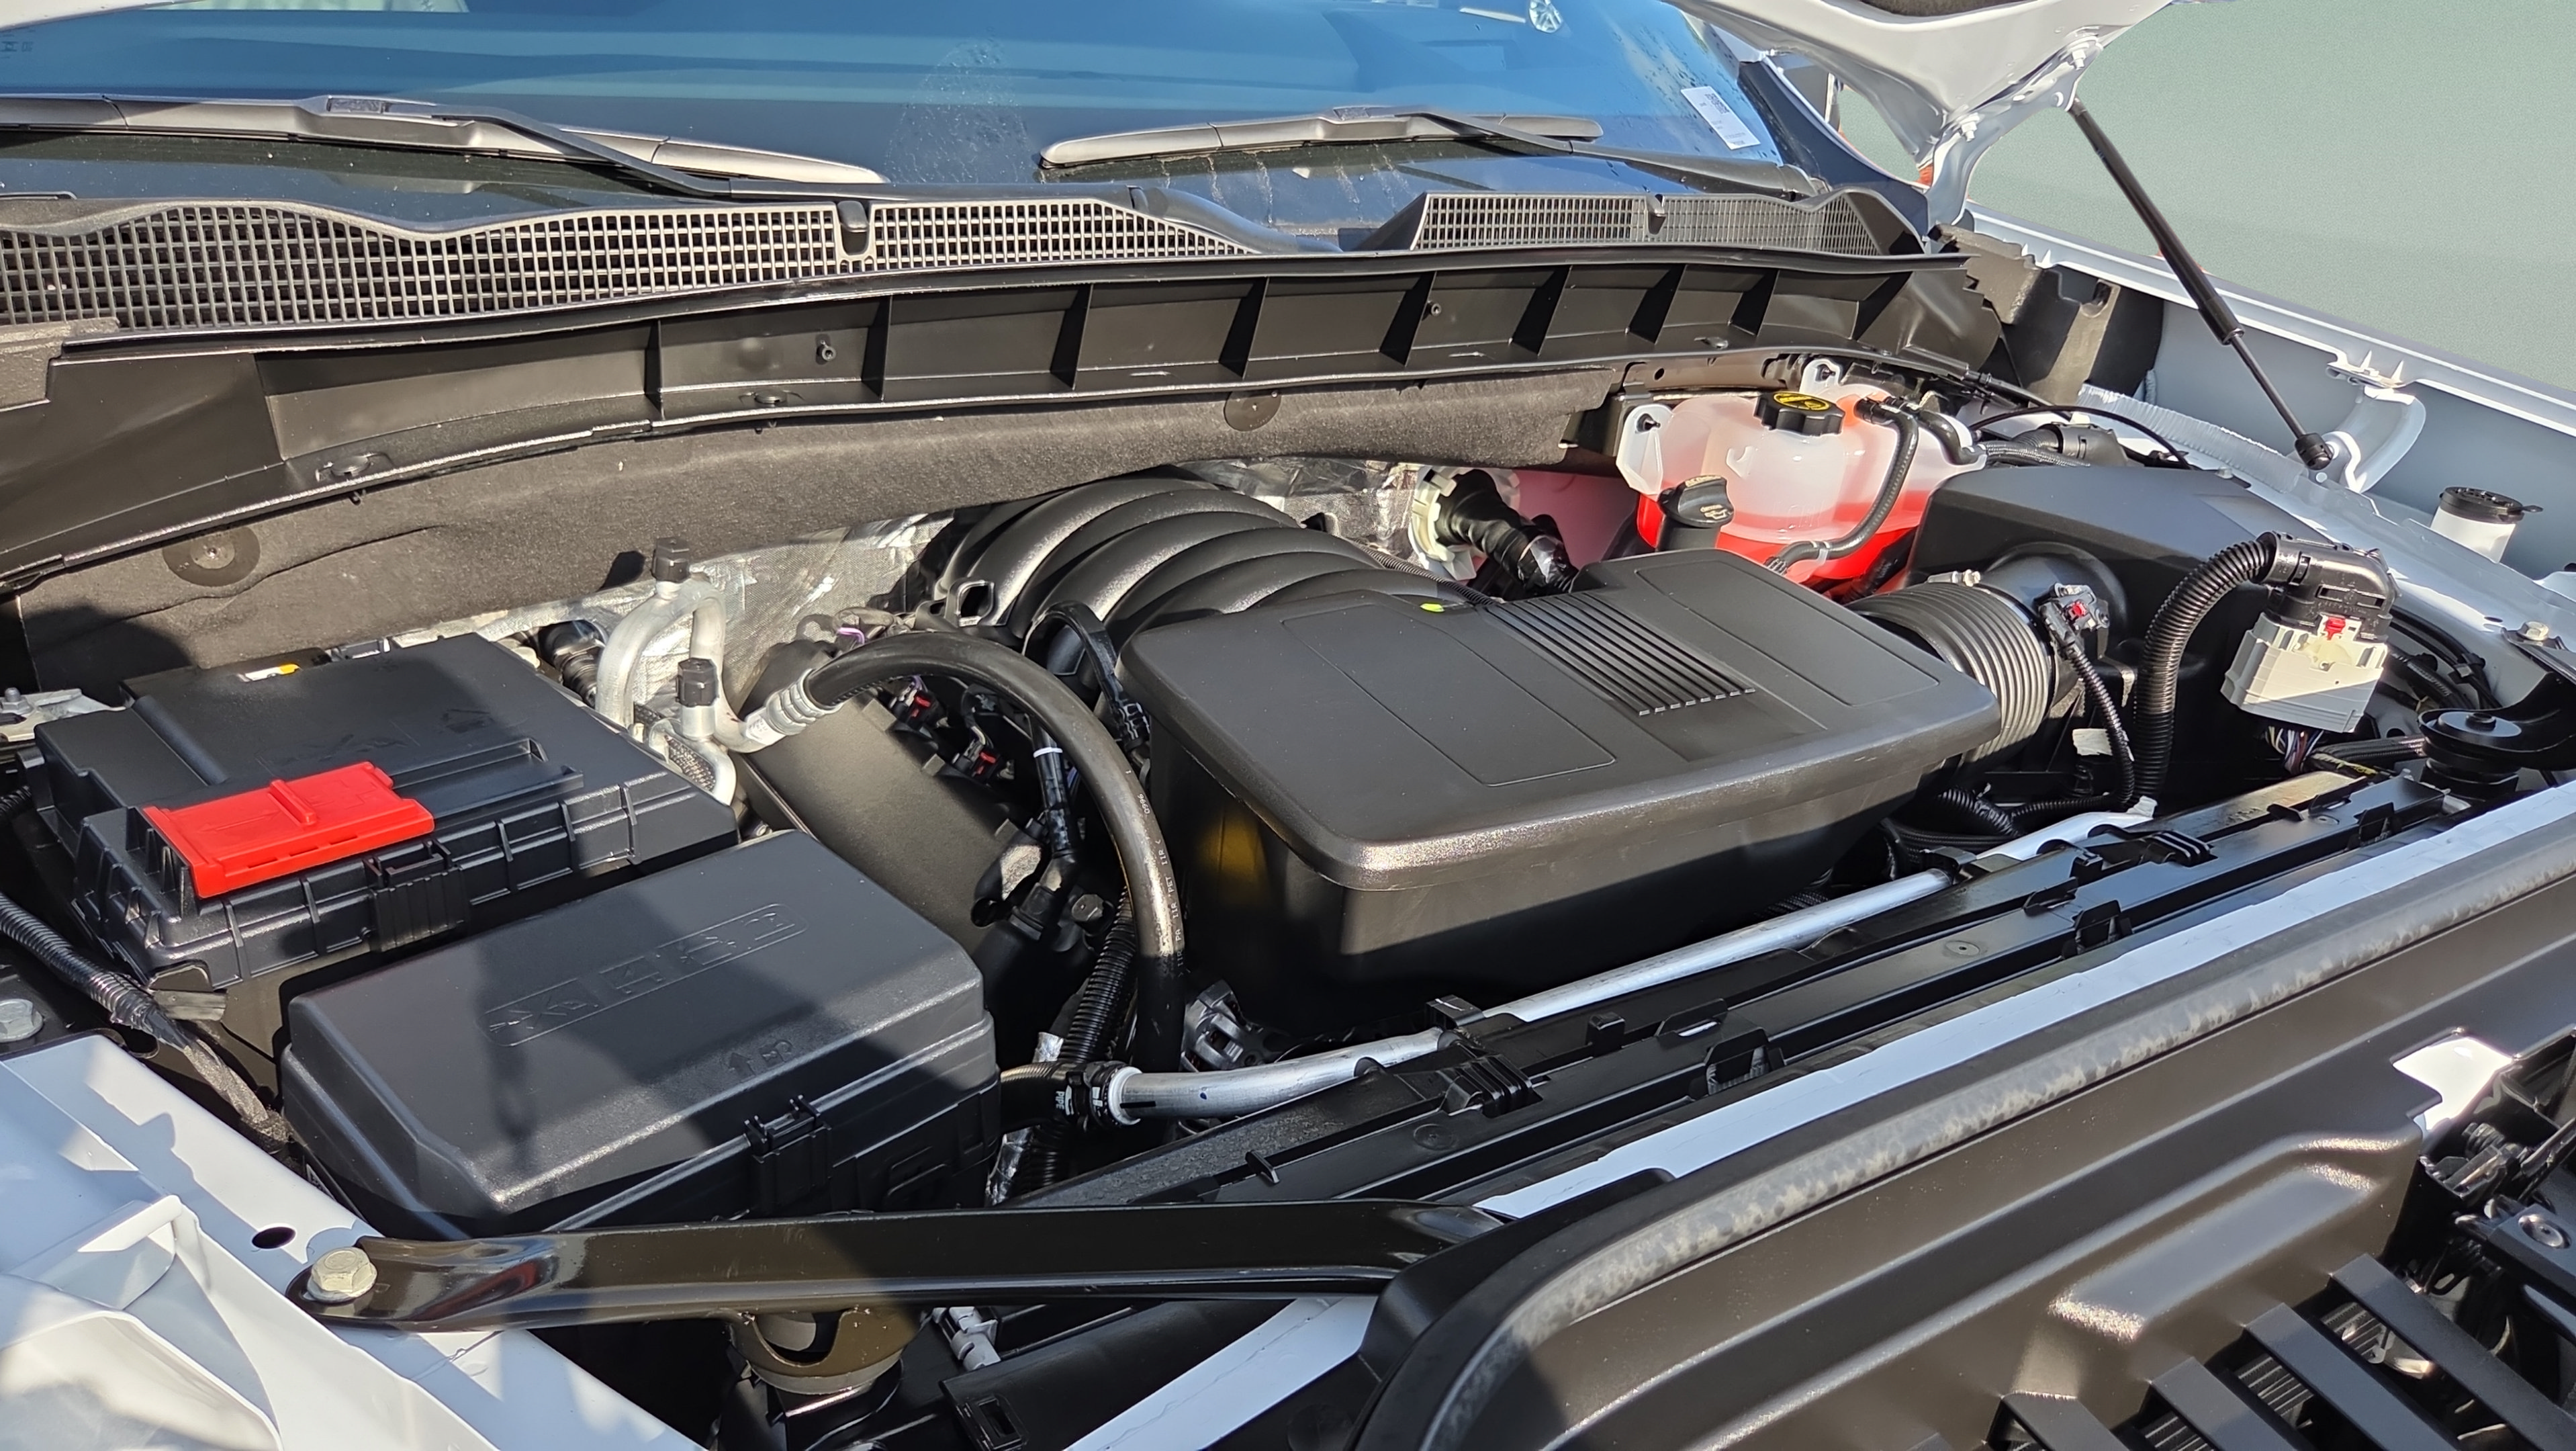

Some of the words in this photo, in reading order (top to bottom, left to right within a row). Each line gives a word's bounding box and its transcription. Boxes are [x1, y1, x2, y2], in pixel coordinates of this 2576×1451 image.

[1158, 849, 1168, 865] IIR
[1165, 876, 1175, 893] PET
[1171, 902, 1179, 919] IIR
[1175, 928, 1182, 942] PA
[1056, 1091, 1066, 1110] PIPE
